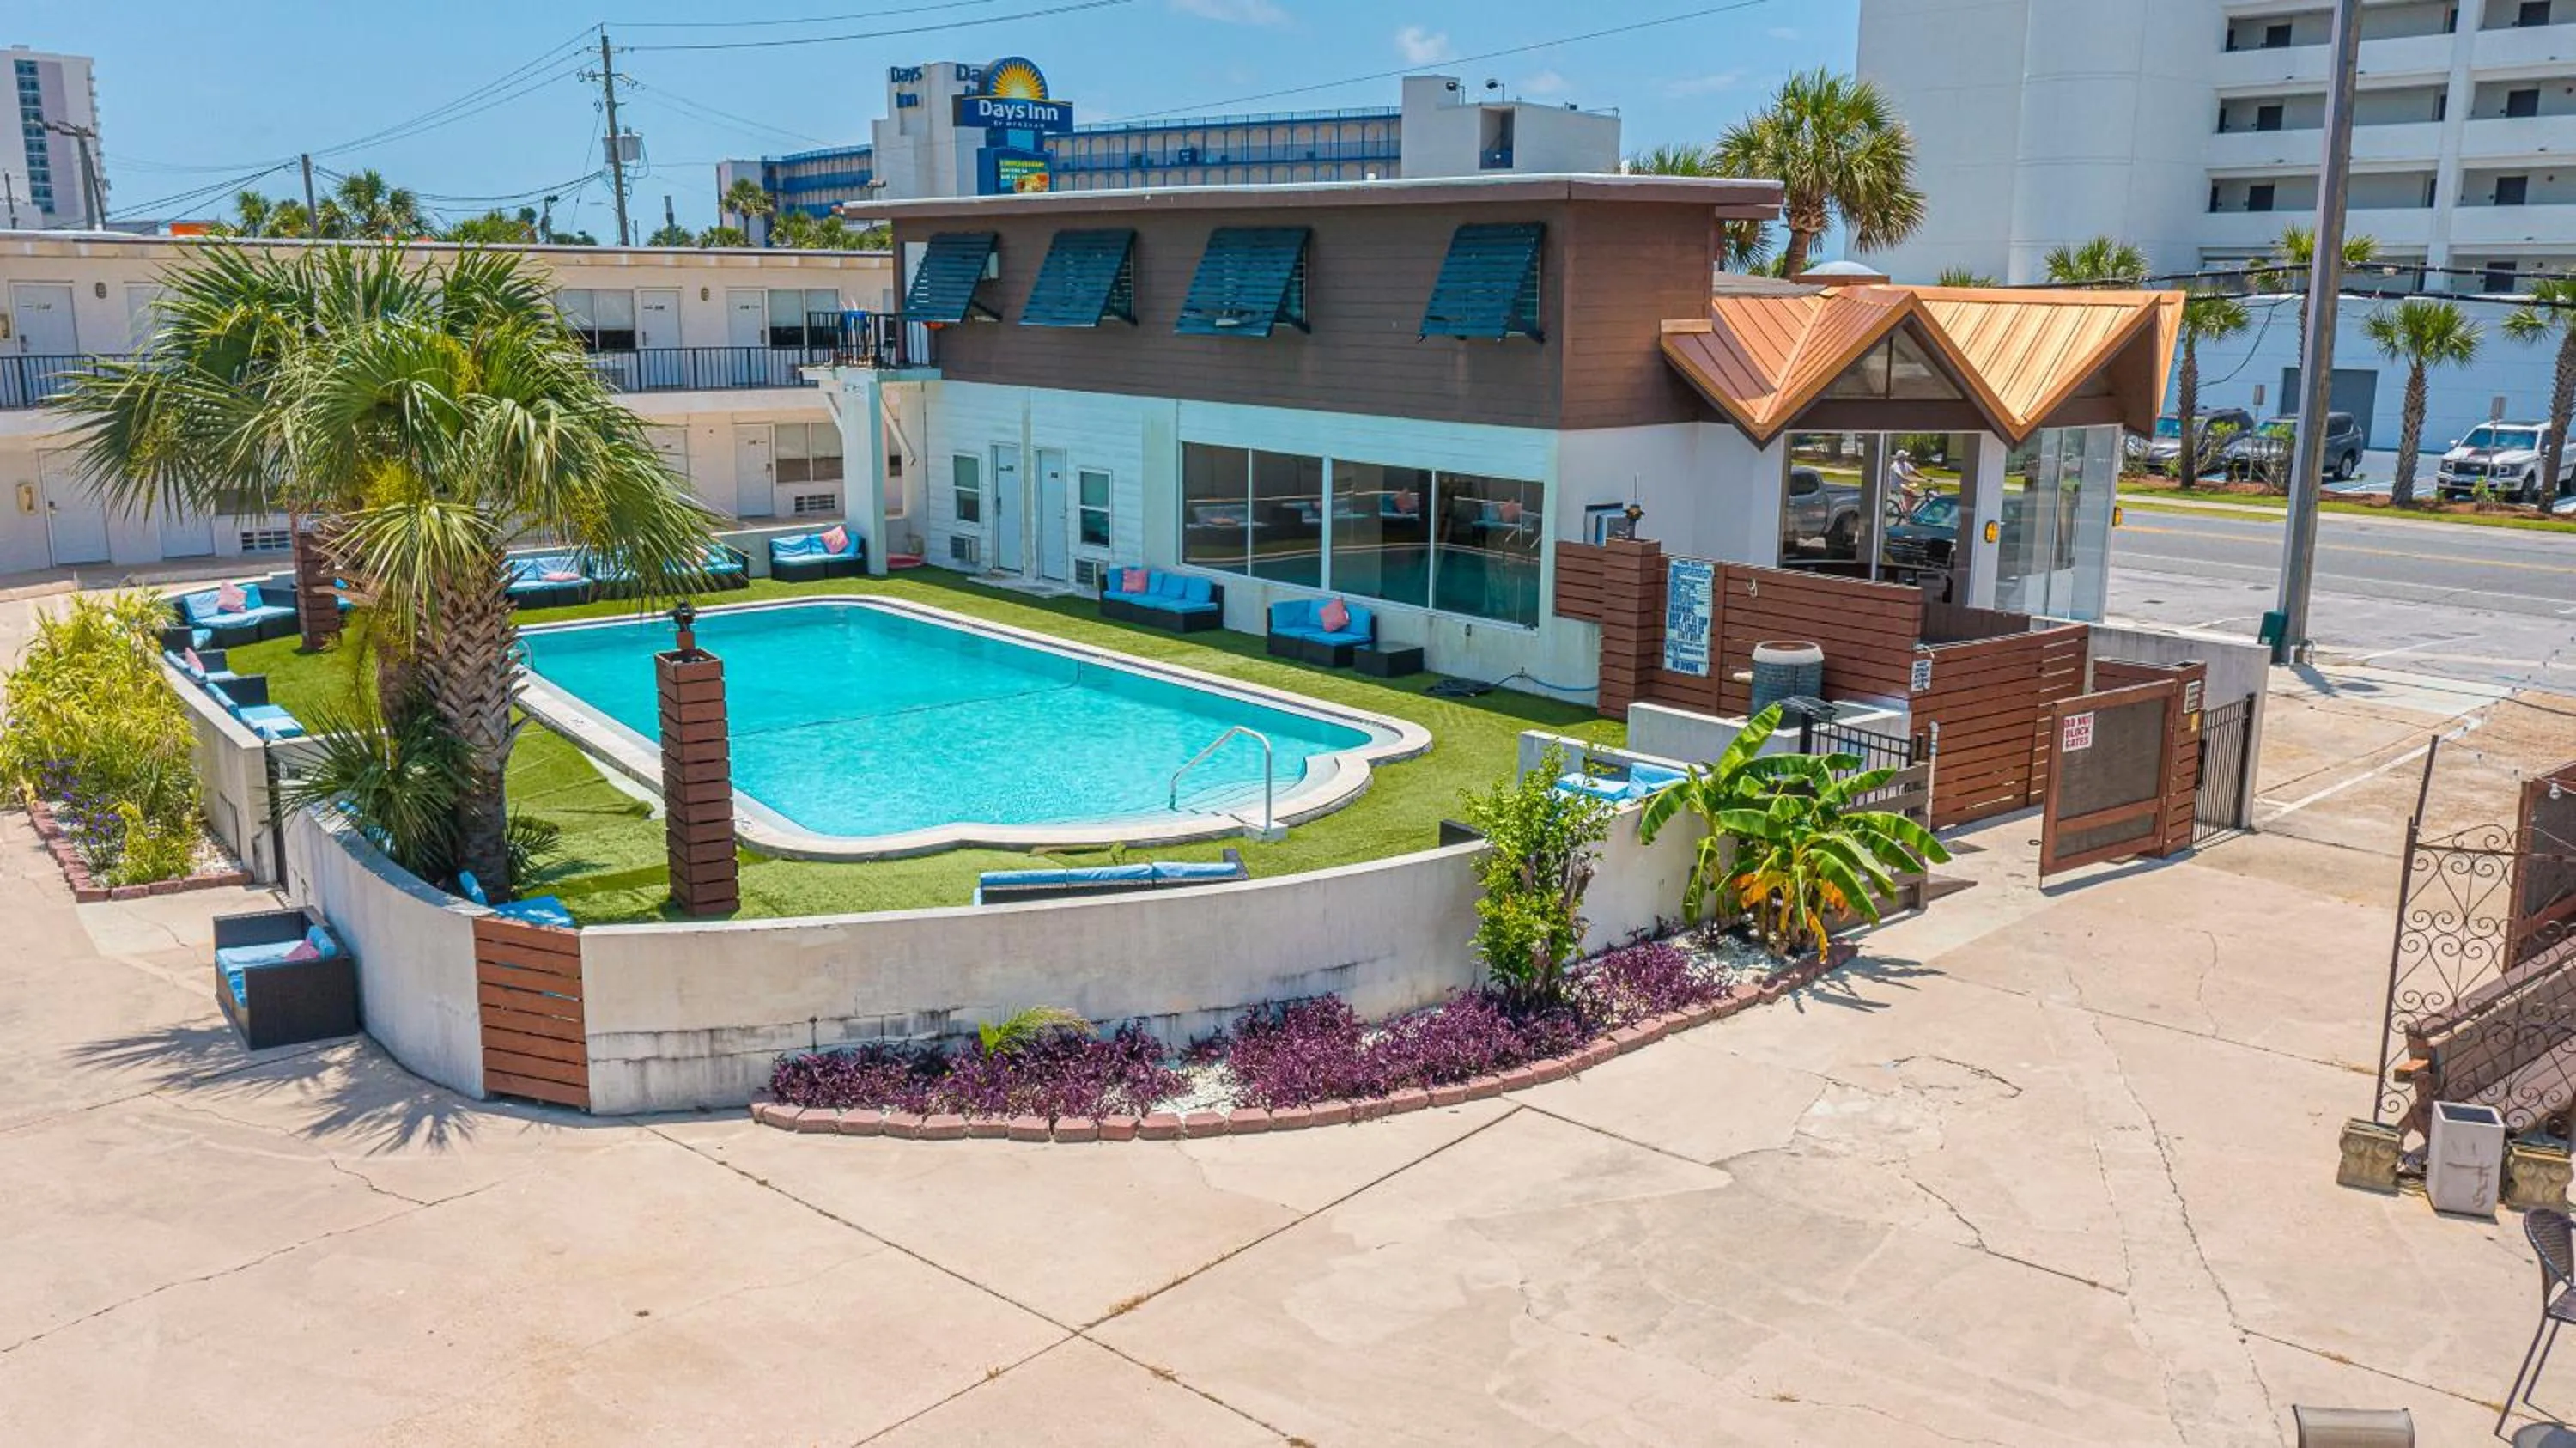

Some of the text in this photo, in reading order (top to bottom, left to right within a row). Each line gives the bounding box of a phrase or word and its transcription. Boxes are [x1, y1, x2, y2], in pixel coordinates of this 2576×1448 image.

[890, 66, 922, 83] Days
[956, 64, 982, 82] Da
[896, 92, 918, 108] Inn
[978, 99, 1059, 120] Days Inn
[2063, 715, 2093, 728] DO NOT
[2065, 727, 2089, 738] BLOCK
[2065, 735, 2089, 747] GATES
